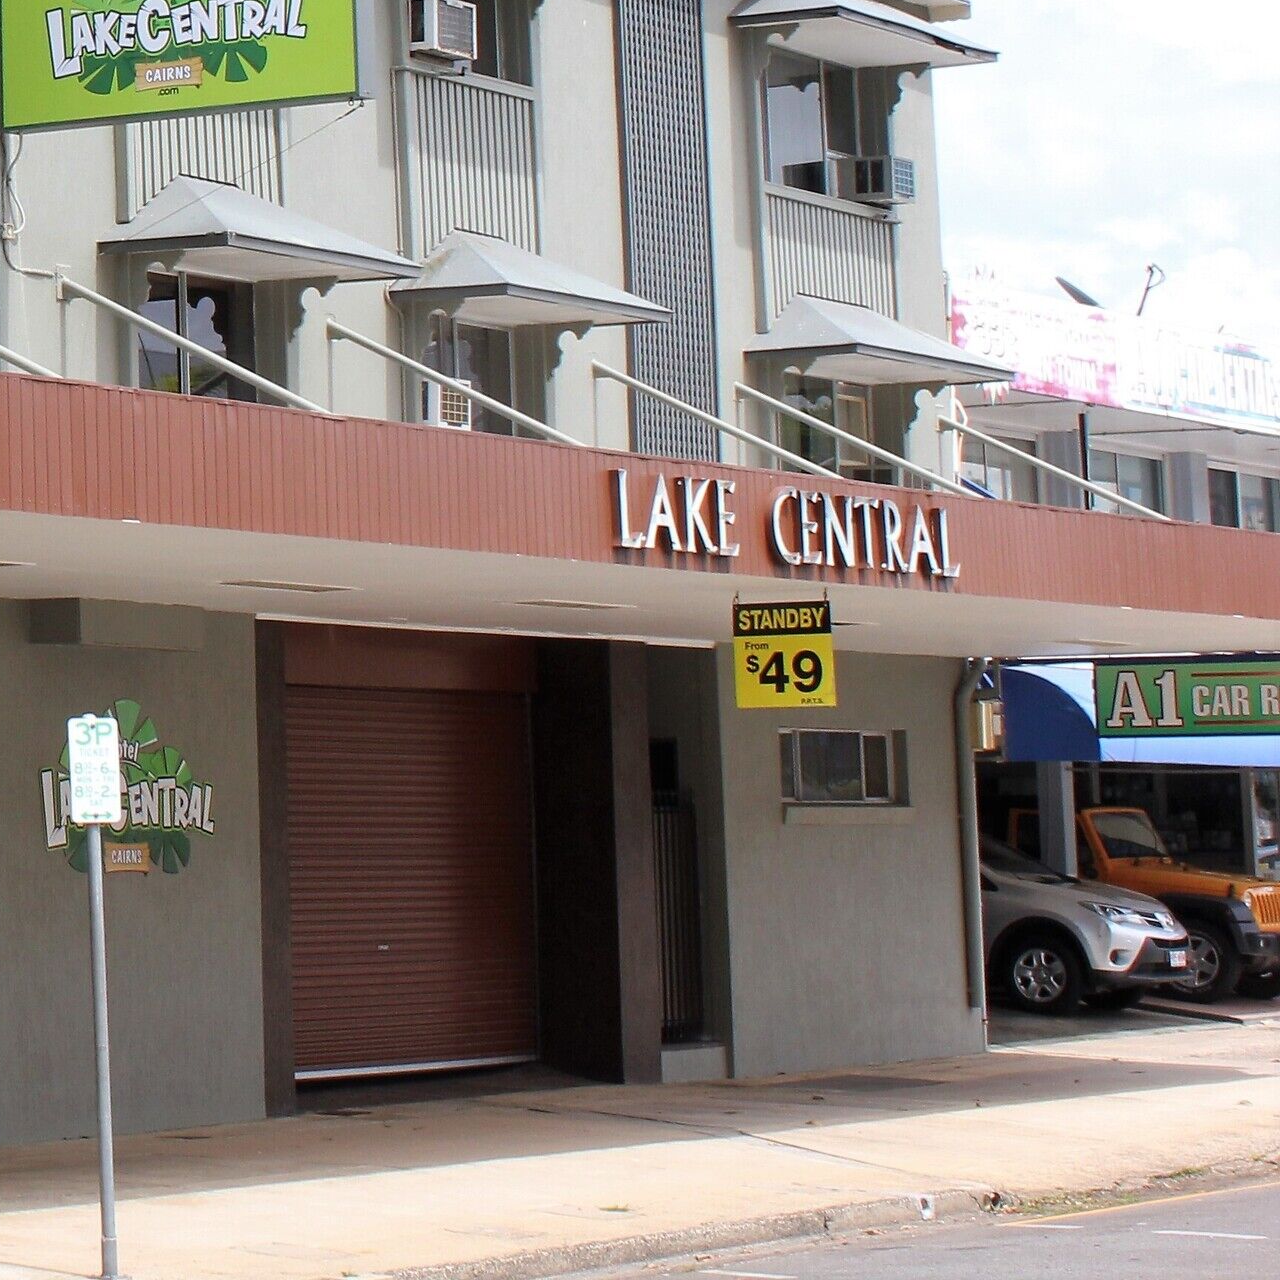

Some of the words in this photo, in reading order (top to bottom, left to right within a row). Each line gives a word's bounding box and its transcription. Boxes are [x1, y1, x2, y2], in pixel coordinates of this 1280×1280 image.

[145, 66, 191, 83] CAIRNS
[157, 87, 179, 96] .com
[610, 468, 741, 557] LAKE
[771, 486, 961, 578] CENTRAL
[738, 607, 825, 631] STANDBY
[744, 642, 769, 651] From
[746, 649, 823, 694] $49
[1106, 670, 1184, 728] A1
[1192, 684, 1251, 717] CAR
[75, 722, 113, 746] 3P
[111, 849, 142, 864] CAIRNS
